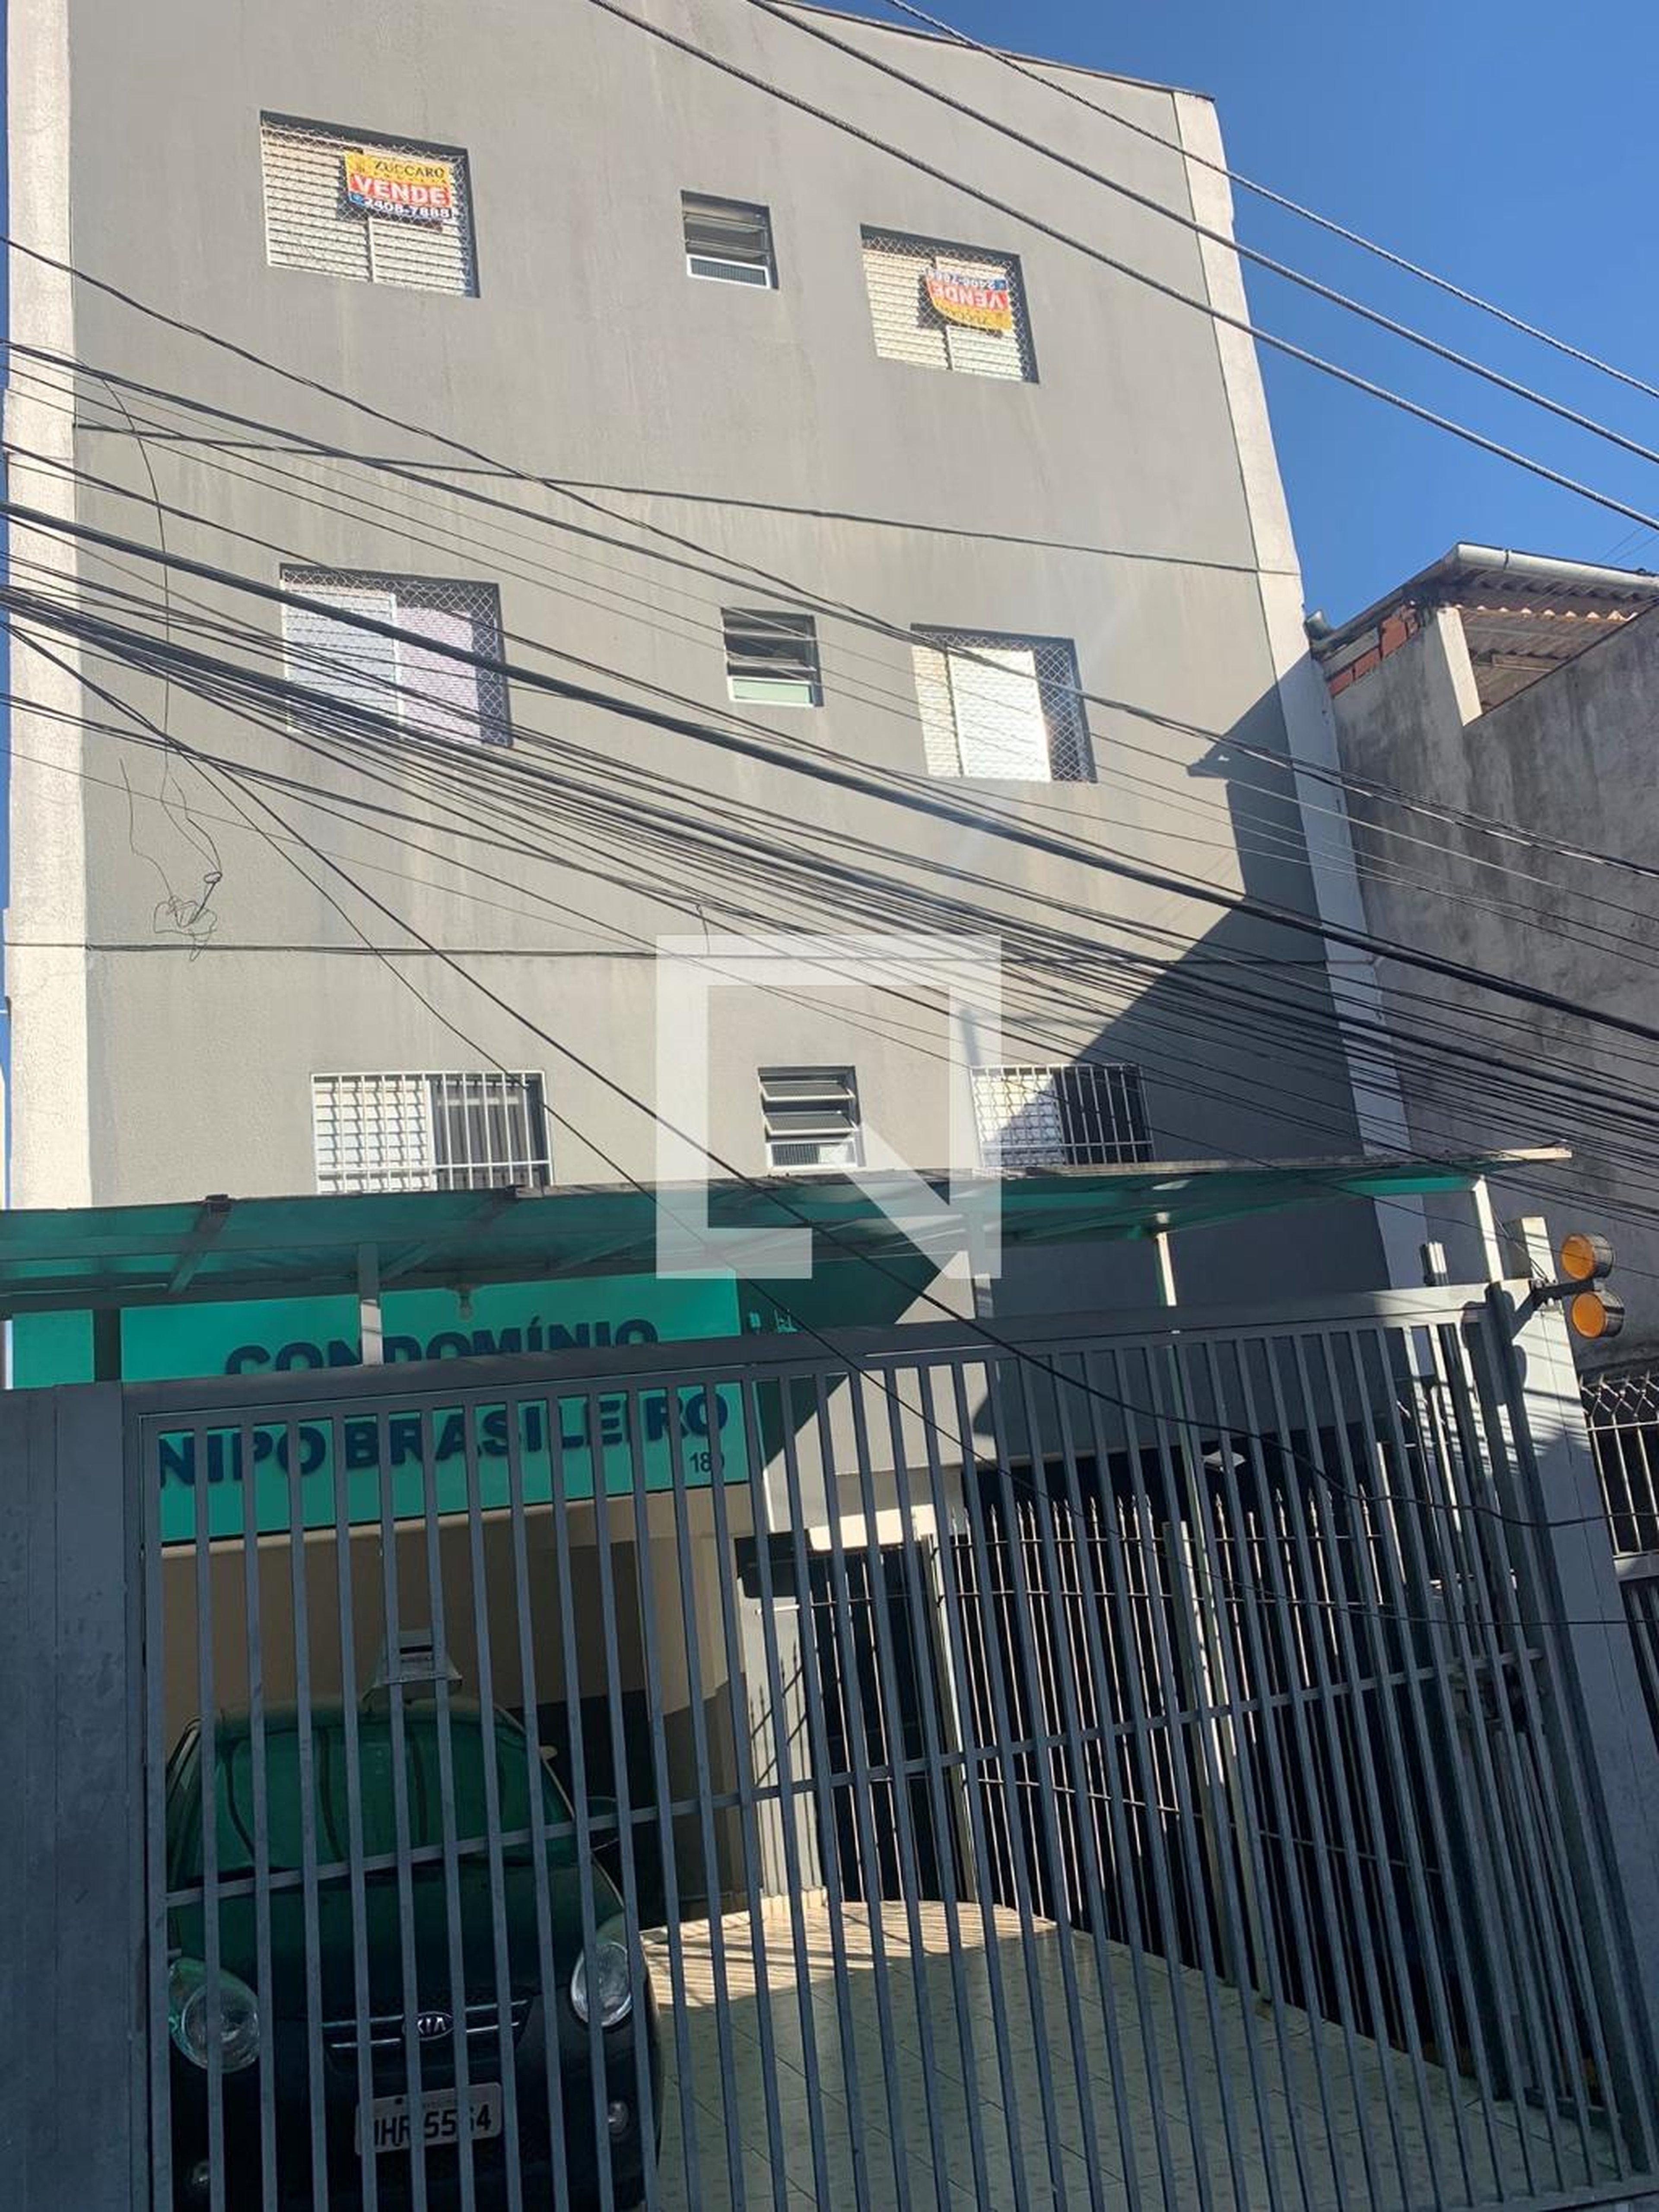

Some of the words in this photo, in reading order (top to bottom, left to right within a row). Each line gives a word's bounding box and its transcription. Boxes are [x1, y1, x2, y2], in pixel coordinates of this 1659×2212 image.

[353, 173, 446, 206] VENDE
[931, 286, 1006, 311] VENDE
[344, 1391, 728, 1472] BRASILERO
[689, 1451, 725, 1473] 18
